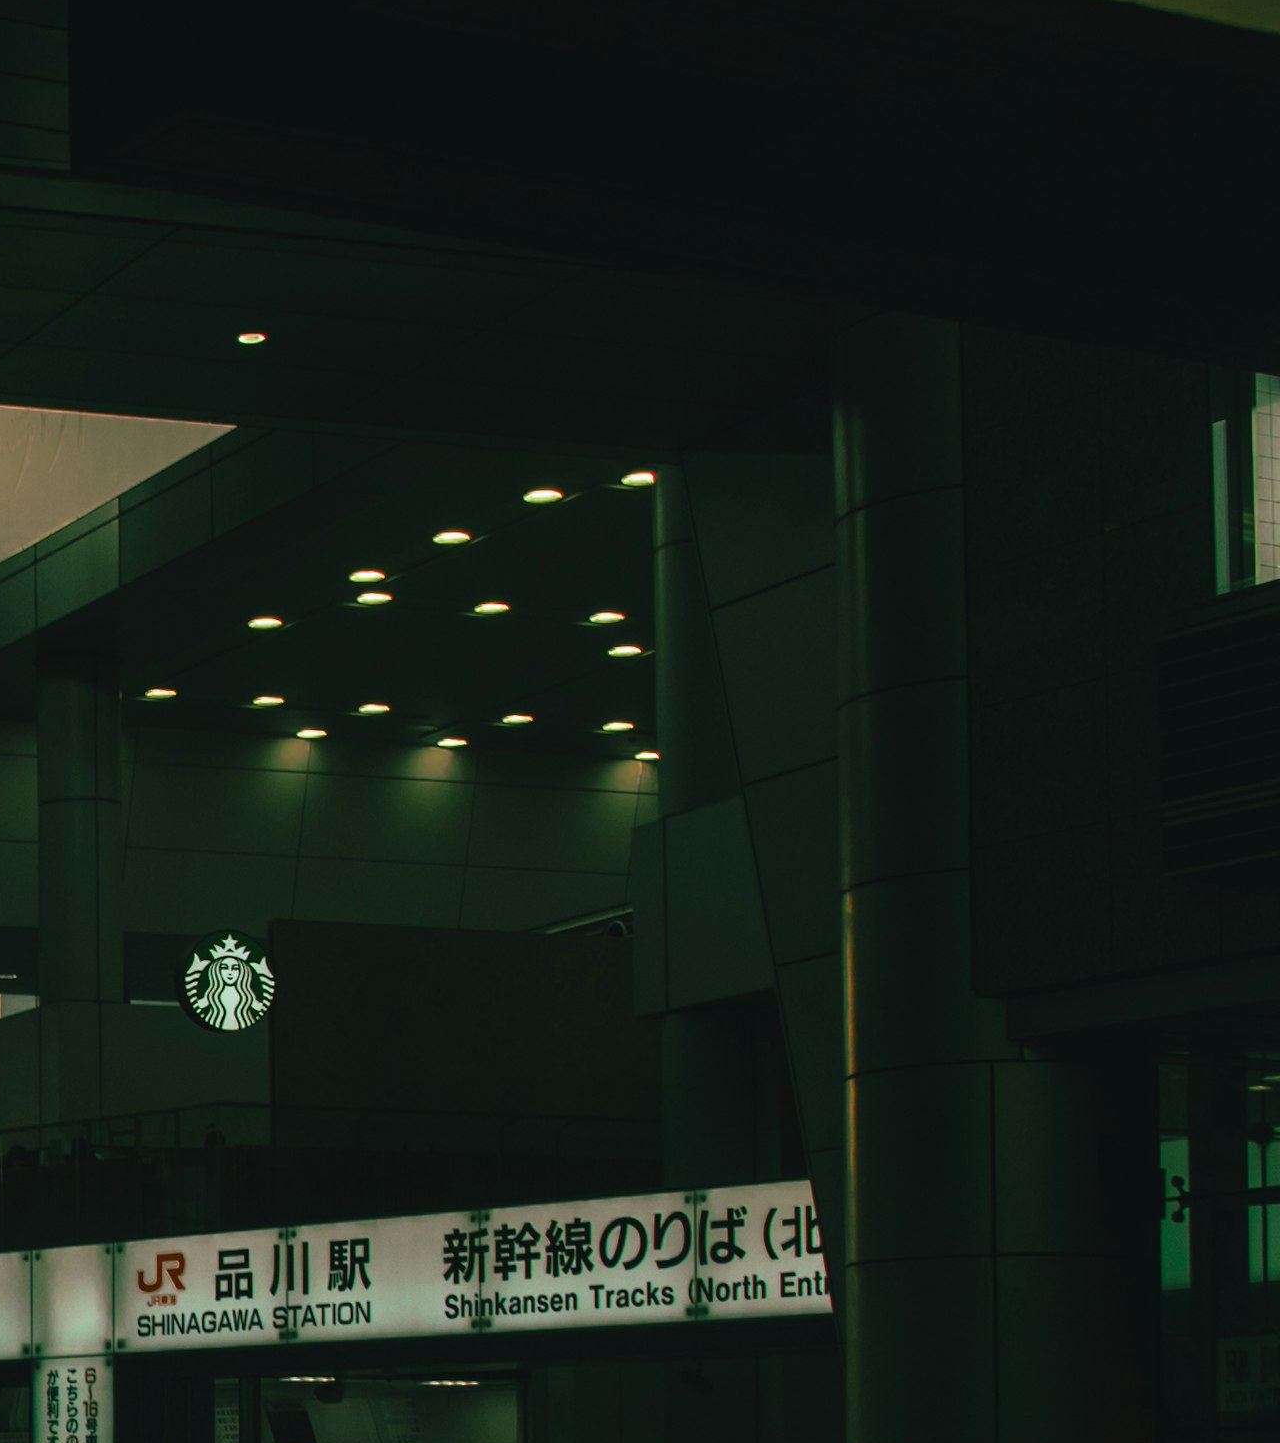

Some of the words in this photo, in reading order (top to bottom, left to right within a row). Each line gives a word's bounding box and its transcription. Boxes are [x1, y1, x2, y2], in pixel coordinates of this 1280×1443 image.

[137, 1252, 186, 1293] JR
[215, 1237, 372, 1301] 品川駅
[137, 1307, 264, 1337] SHINAGAWA
[272, 1300, 372, 1330] STATION
[444, 1289, 578, 1320] Shinkansen
[588, 1281, 675, 1311] Tracks
[687, 1274, 767, 1304] (North
